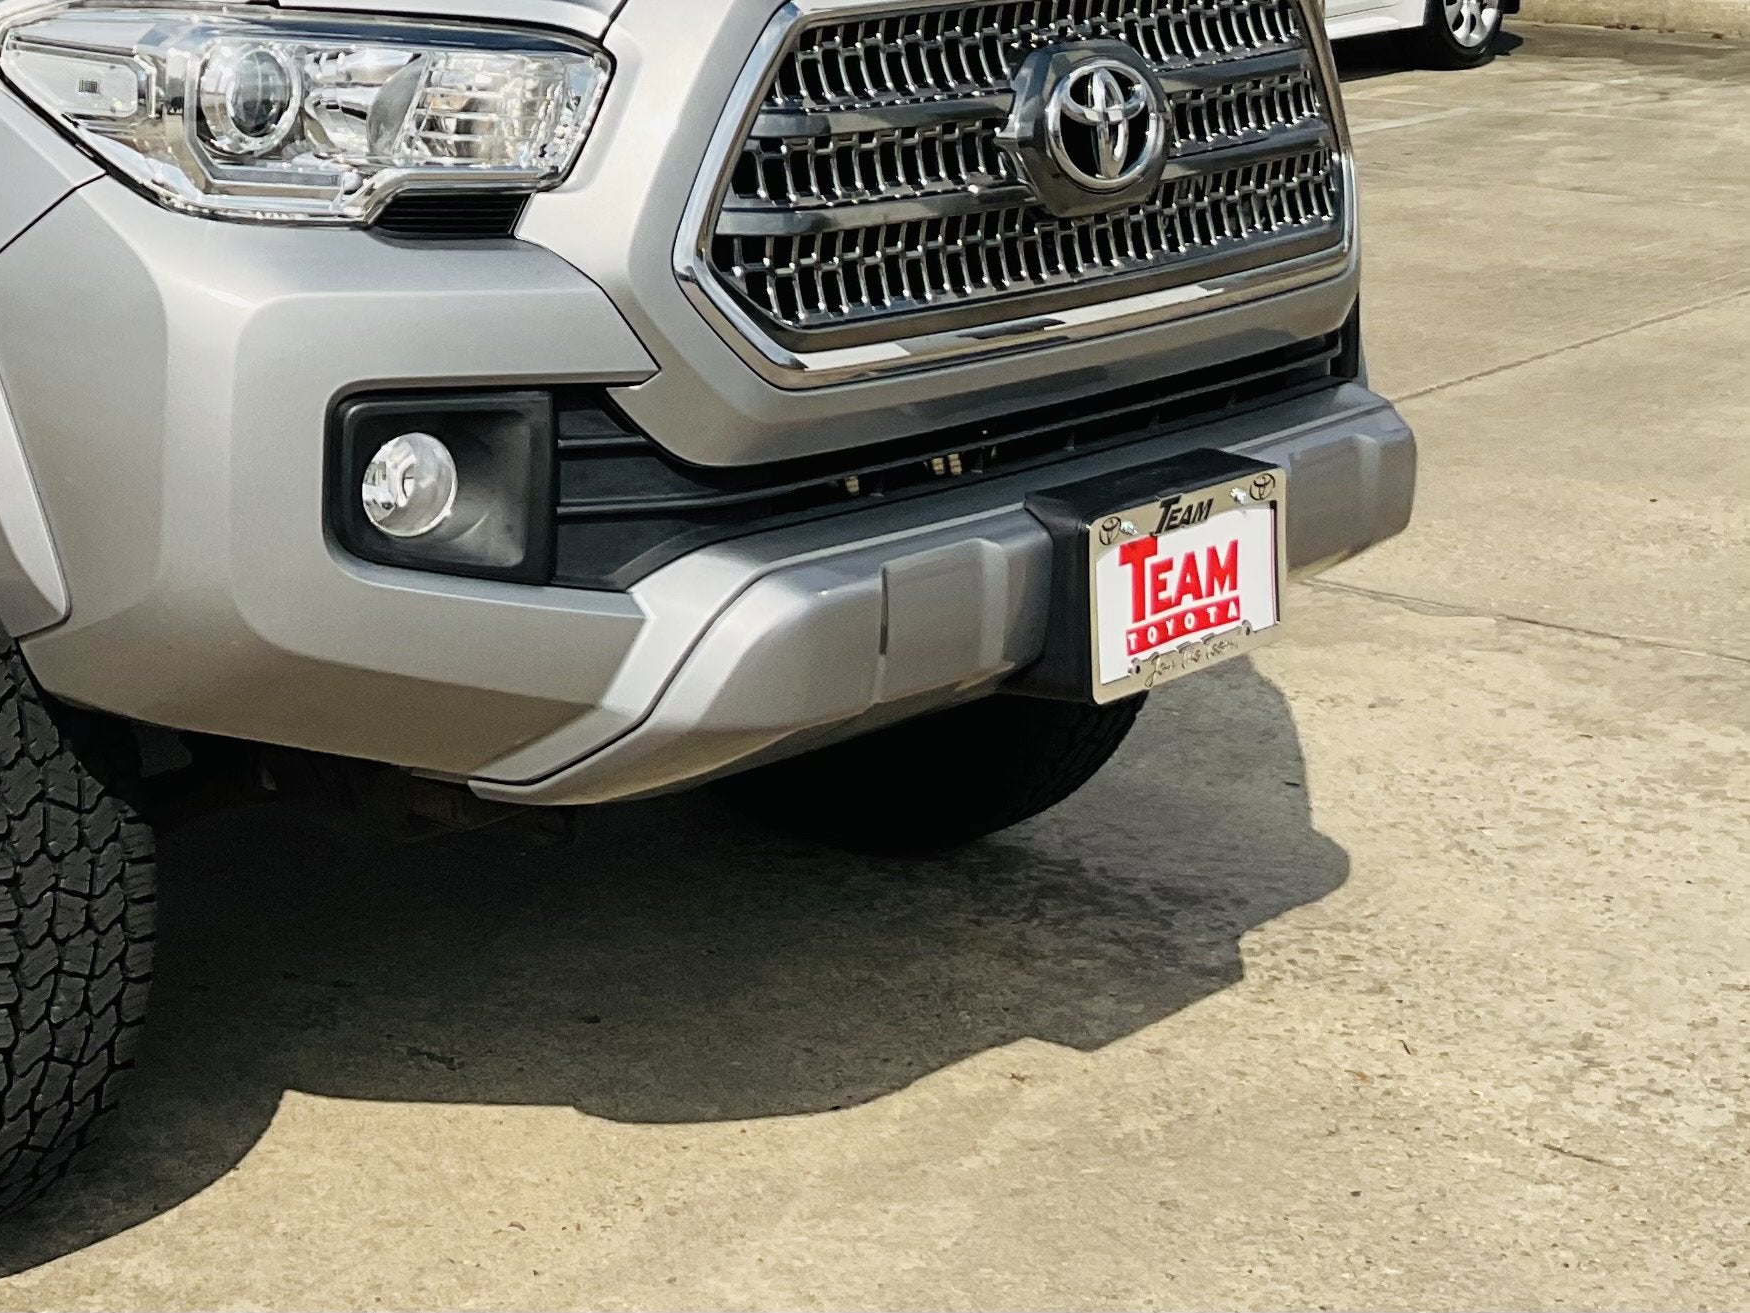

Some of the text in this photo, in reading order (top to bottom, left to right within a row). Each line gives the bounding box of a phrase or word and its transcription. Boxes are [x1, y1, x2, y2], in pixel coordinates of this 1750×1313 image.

[1154, 494, 1214, 535] TEAM
[1119, 535, 1239, 624] TEAM
[1127, 600, 1238, 650] TOYOTA
